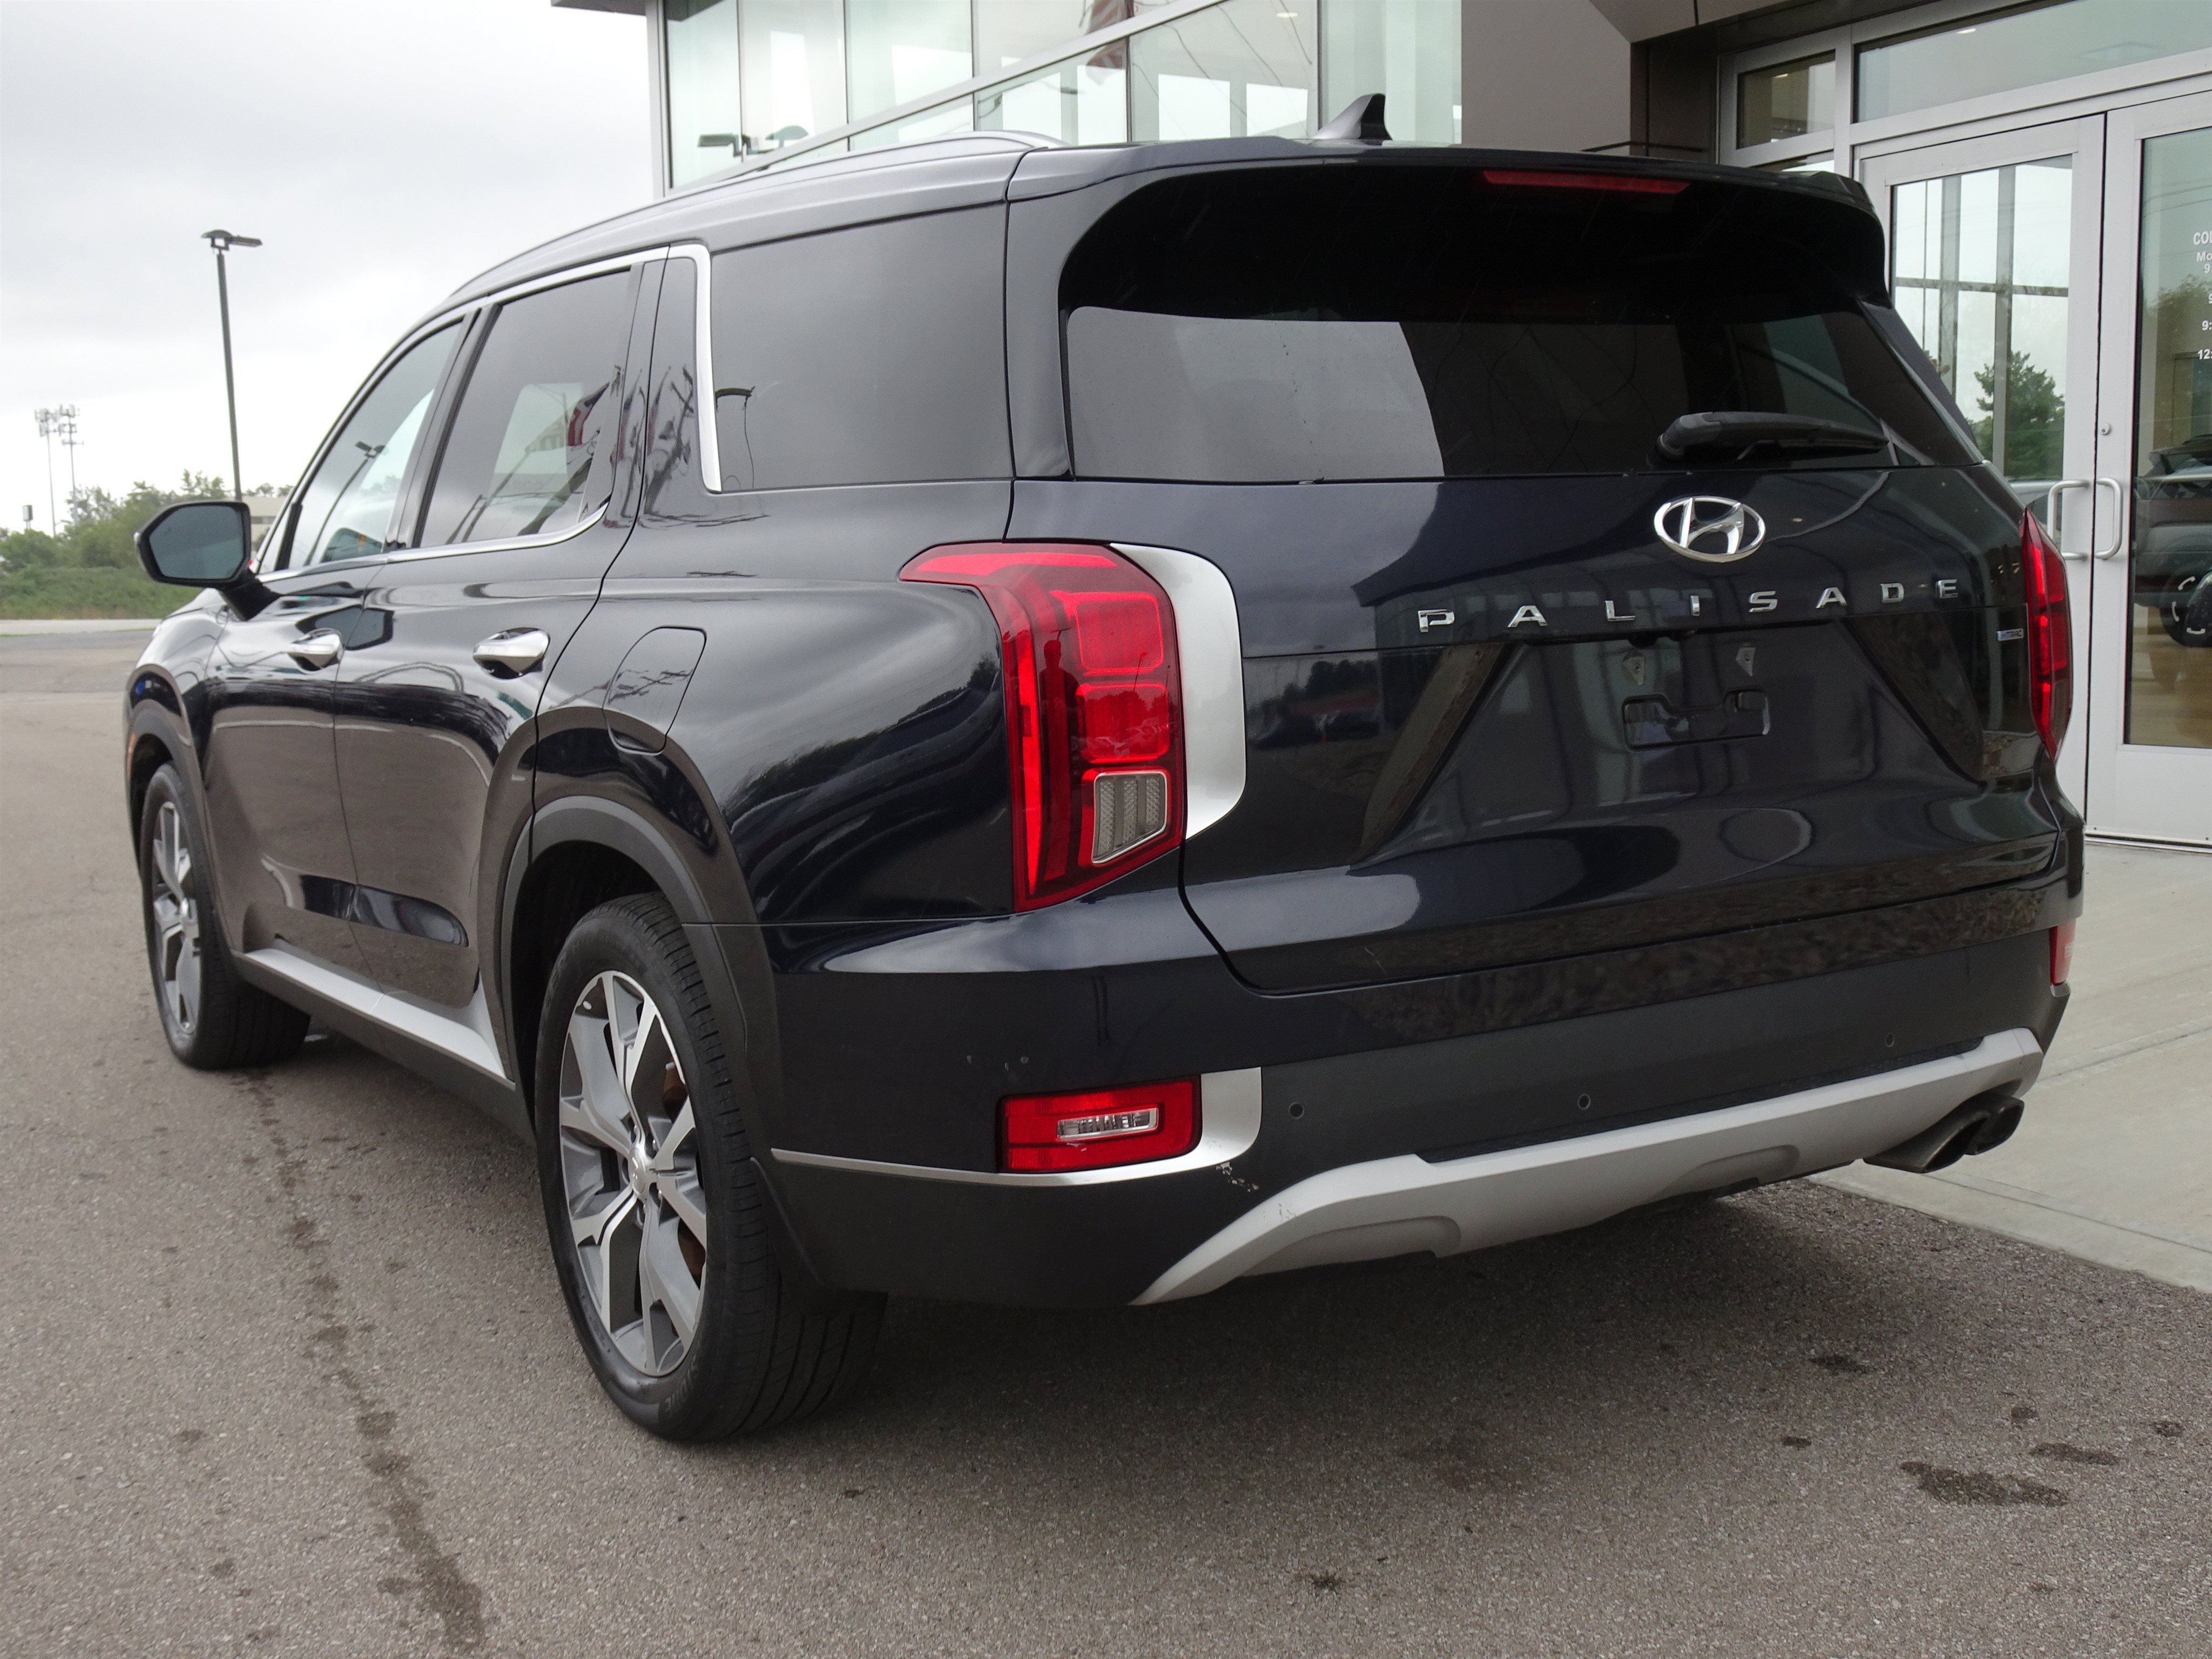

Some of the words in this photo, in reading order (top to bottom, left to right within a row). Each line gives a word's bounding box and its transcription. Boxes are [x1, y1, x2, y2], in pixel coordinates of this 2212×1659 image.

[2197, 251, 2212, 262] Mo
[2204, 263, 2212, 273] 9
[1417, 578, 1958, 633] PALISADE
